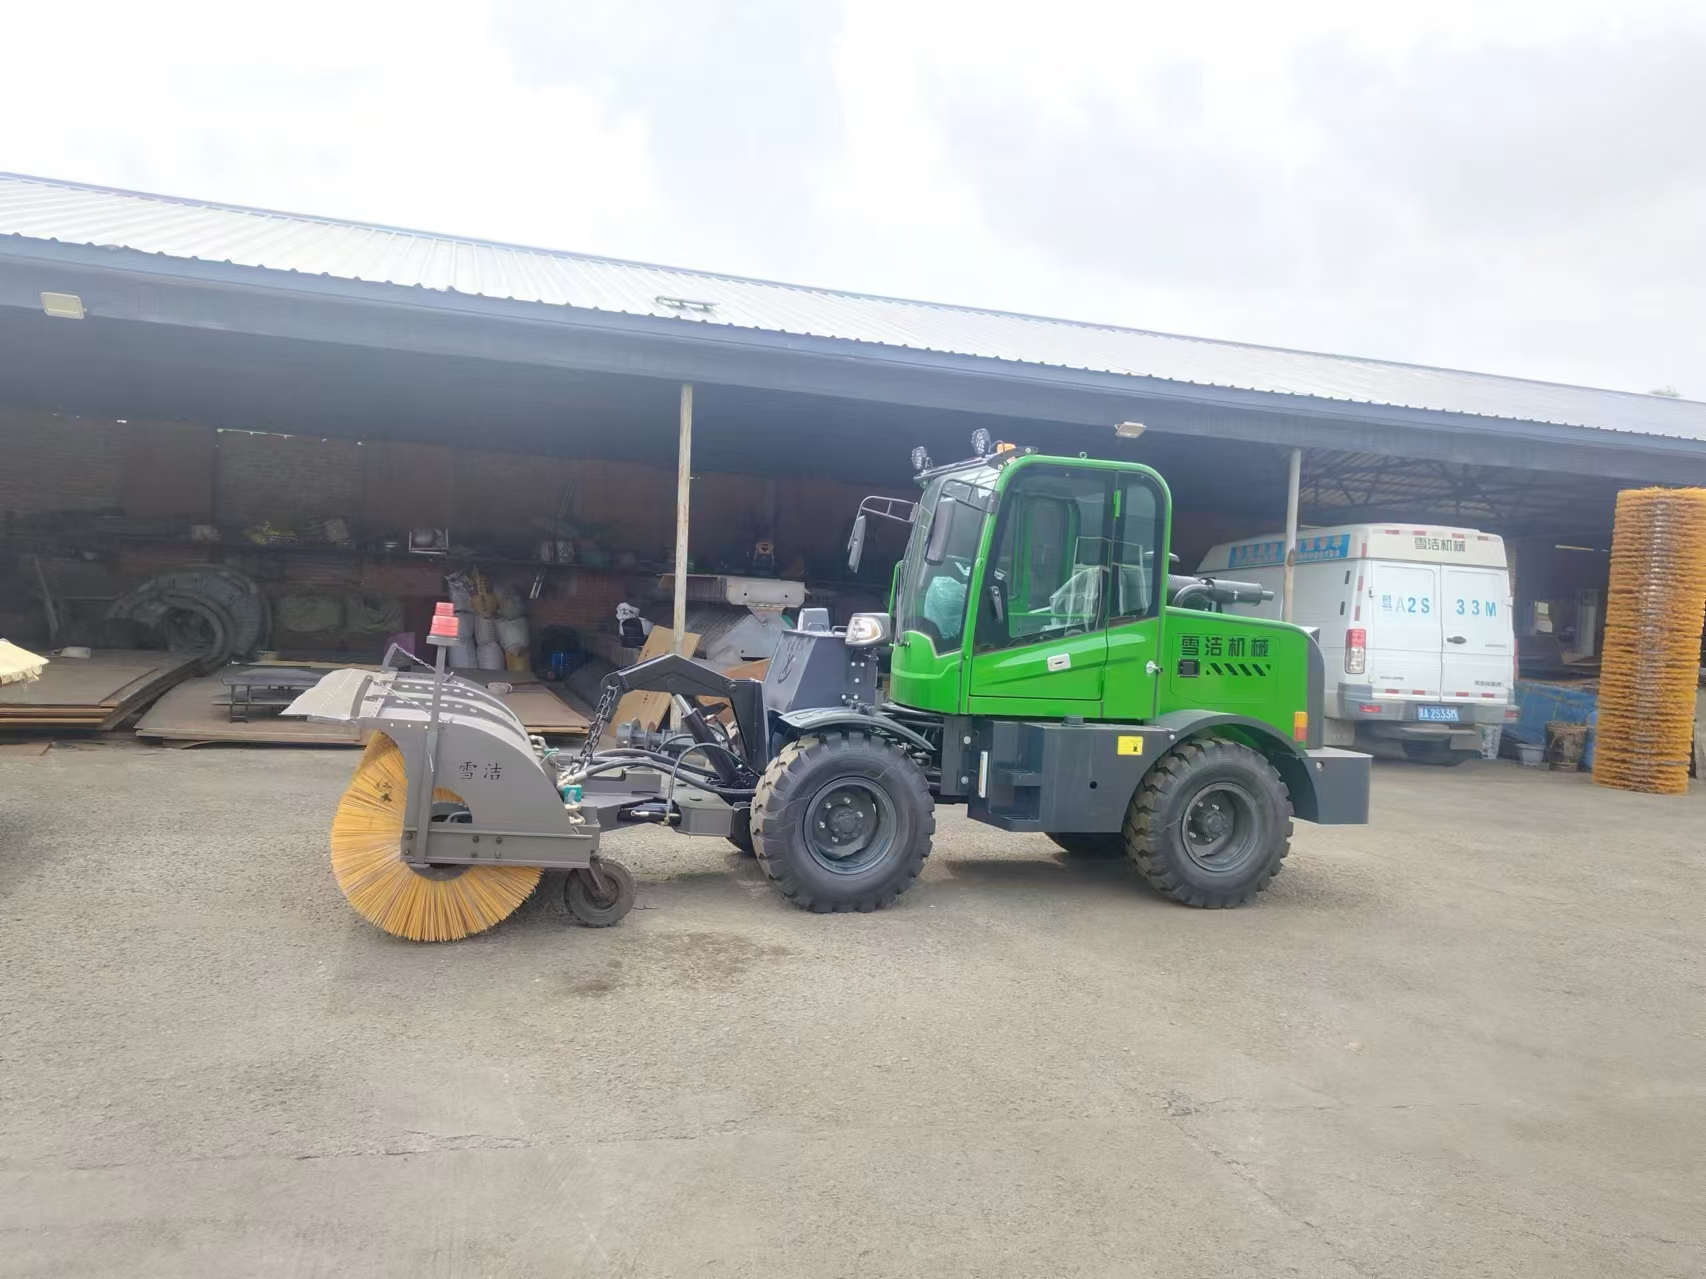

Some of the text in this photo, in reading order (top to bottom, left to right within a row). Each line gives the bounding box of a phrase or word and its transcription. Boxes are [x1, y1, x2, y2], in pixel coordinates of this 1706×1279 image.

[1456, 599, 1497, 616] 33M
[1181, 636, 1269, 656] 雪洁机械
[459, 761, 503, 780] 雪洁
